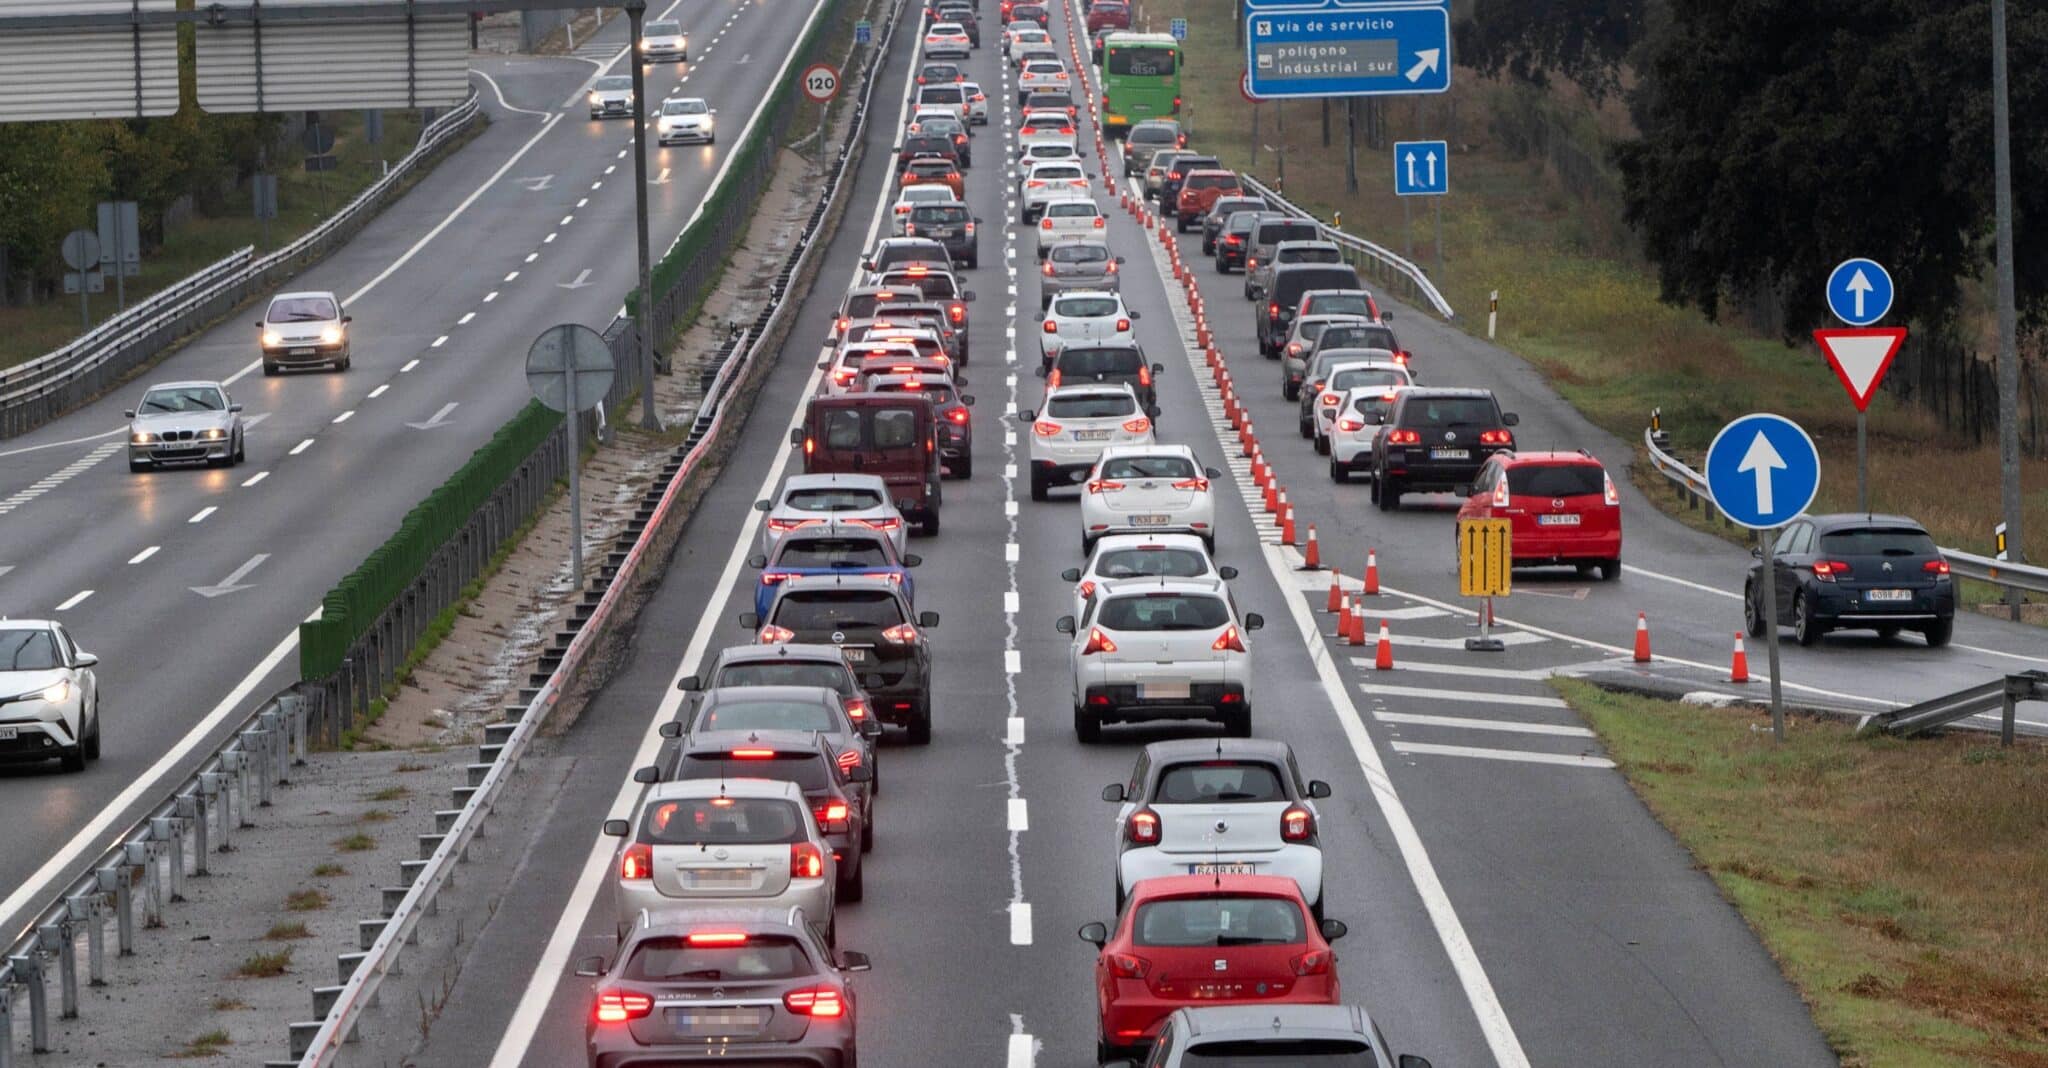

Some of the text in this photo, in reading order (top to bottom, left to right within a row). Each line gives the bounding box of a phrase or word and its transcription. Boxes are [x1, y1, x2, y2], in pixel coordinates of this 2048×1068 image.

[1306, 20, 1324, 32] de
[1330, 18, 1394, 31] servicio
[1279, 61, 1393, 74] industrial sur
[808, 77, 834, 90] 120
